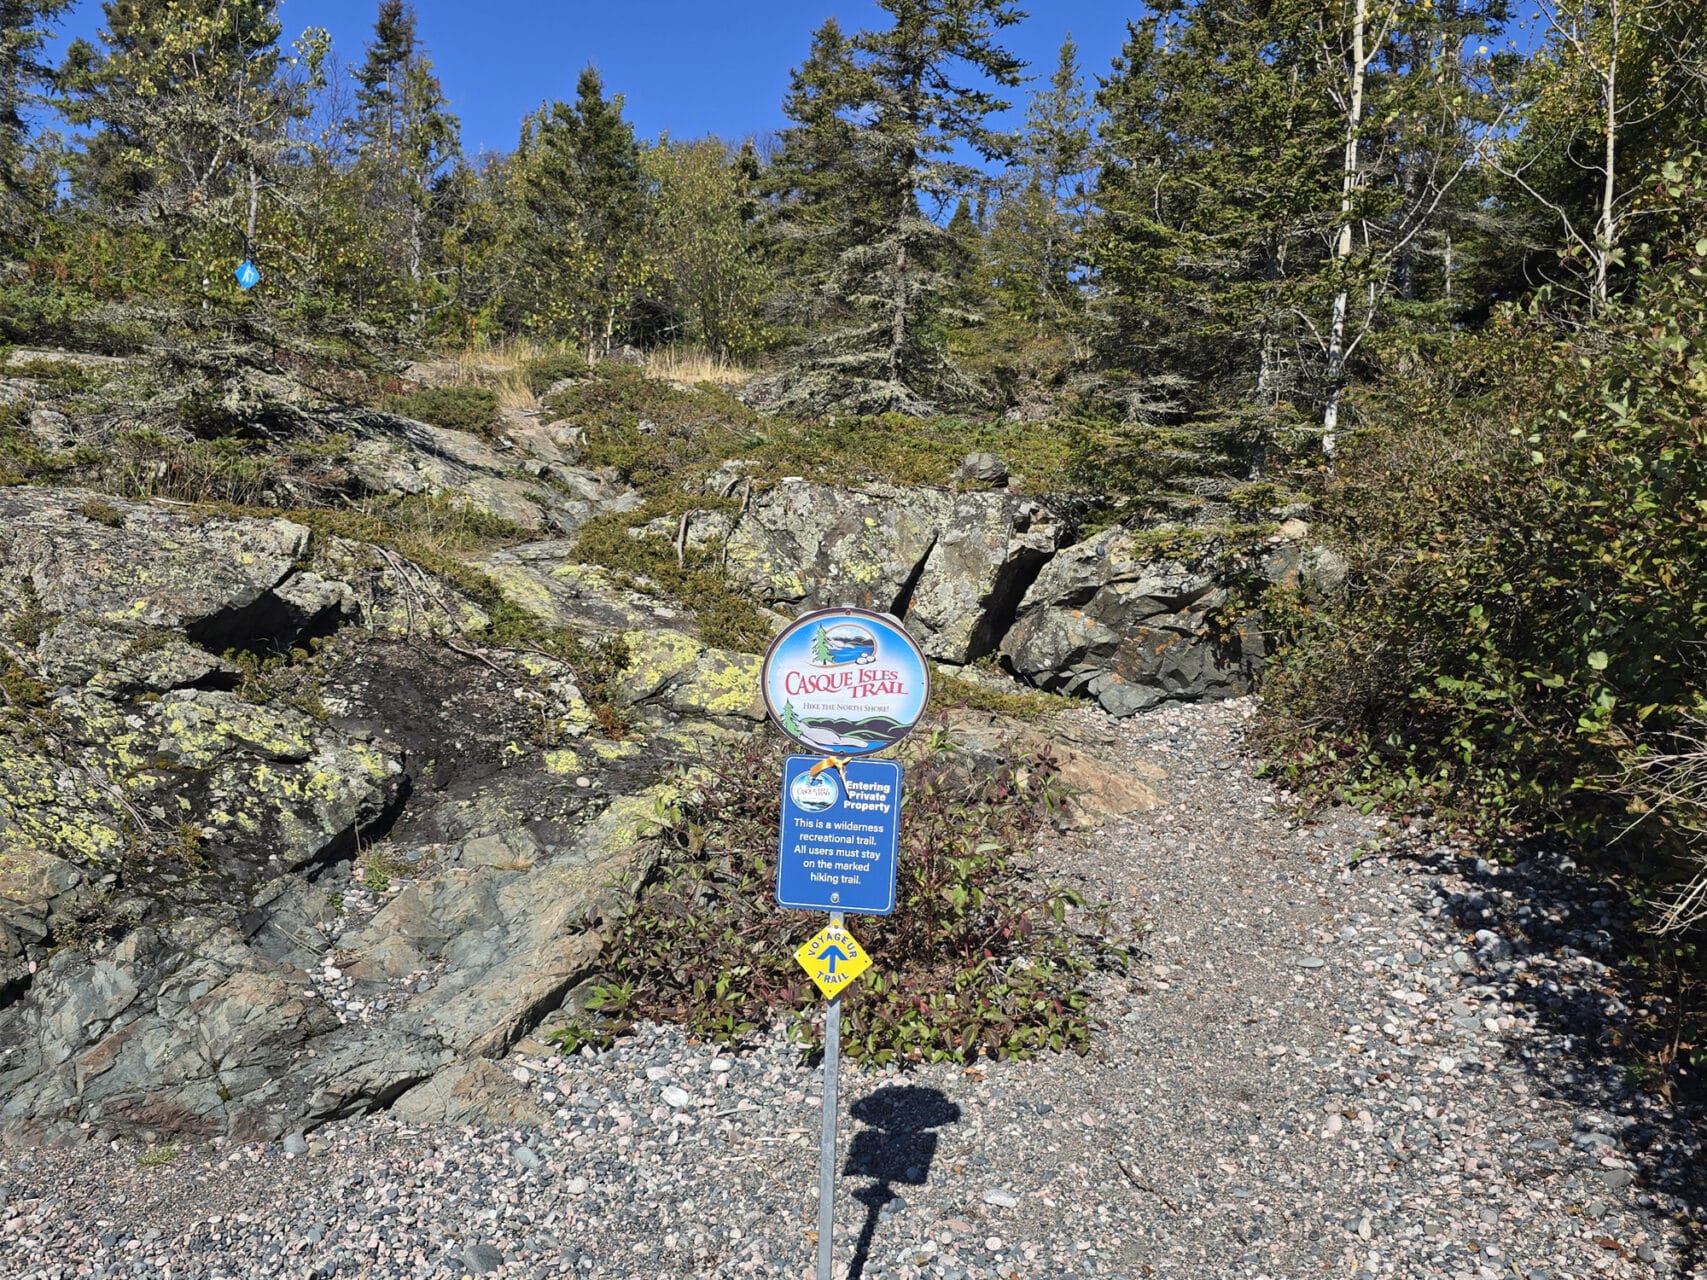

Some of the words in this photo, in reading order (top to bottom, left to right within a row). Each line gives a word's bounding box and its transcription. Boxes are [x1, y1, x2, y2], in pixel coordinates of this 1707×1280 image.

[785, 671, 853, 696] CASQUE
[858, 669, 898, 682] ISLES
[847, 681, 909, 698] TRAIL
[803, 702, 819, 710] HIKE
[821, 703, 835, 711] THE
[864, 704, 889, 712] SHORE!
[847, 780, 890, 794] Entering
[849, 791, 886, 802] Private
[844, 800, 890, 814] Property
[794, 818, 814, 828] This
[816, 820, 823, 829] is
[834, 821, 884, 832] wilderness
[799, 833, 854, 844] recreational
[856, 834, 876, 845] trail.
[794, 845, 806, 854] All
[808, 848, 833, 856] users
[835, 848, 859, 858] must
[862, 849, 880, 860] stay
[803, 860, 815, 868] on
[817, 860, 832, 870] the
[835, 861, 869, 872] marked
[810, 872, 838, 884] hiking
[841, 874, 861, 885] trail.
[807, 932, 858, 959] VOYAGEUR
[816, 970, 849, 984] TRAIL
